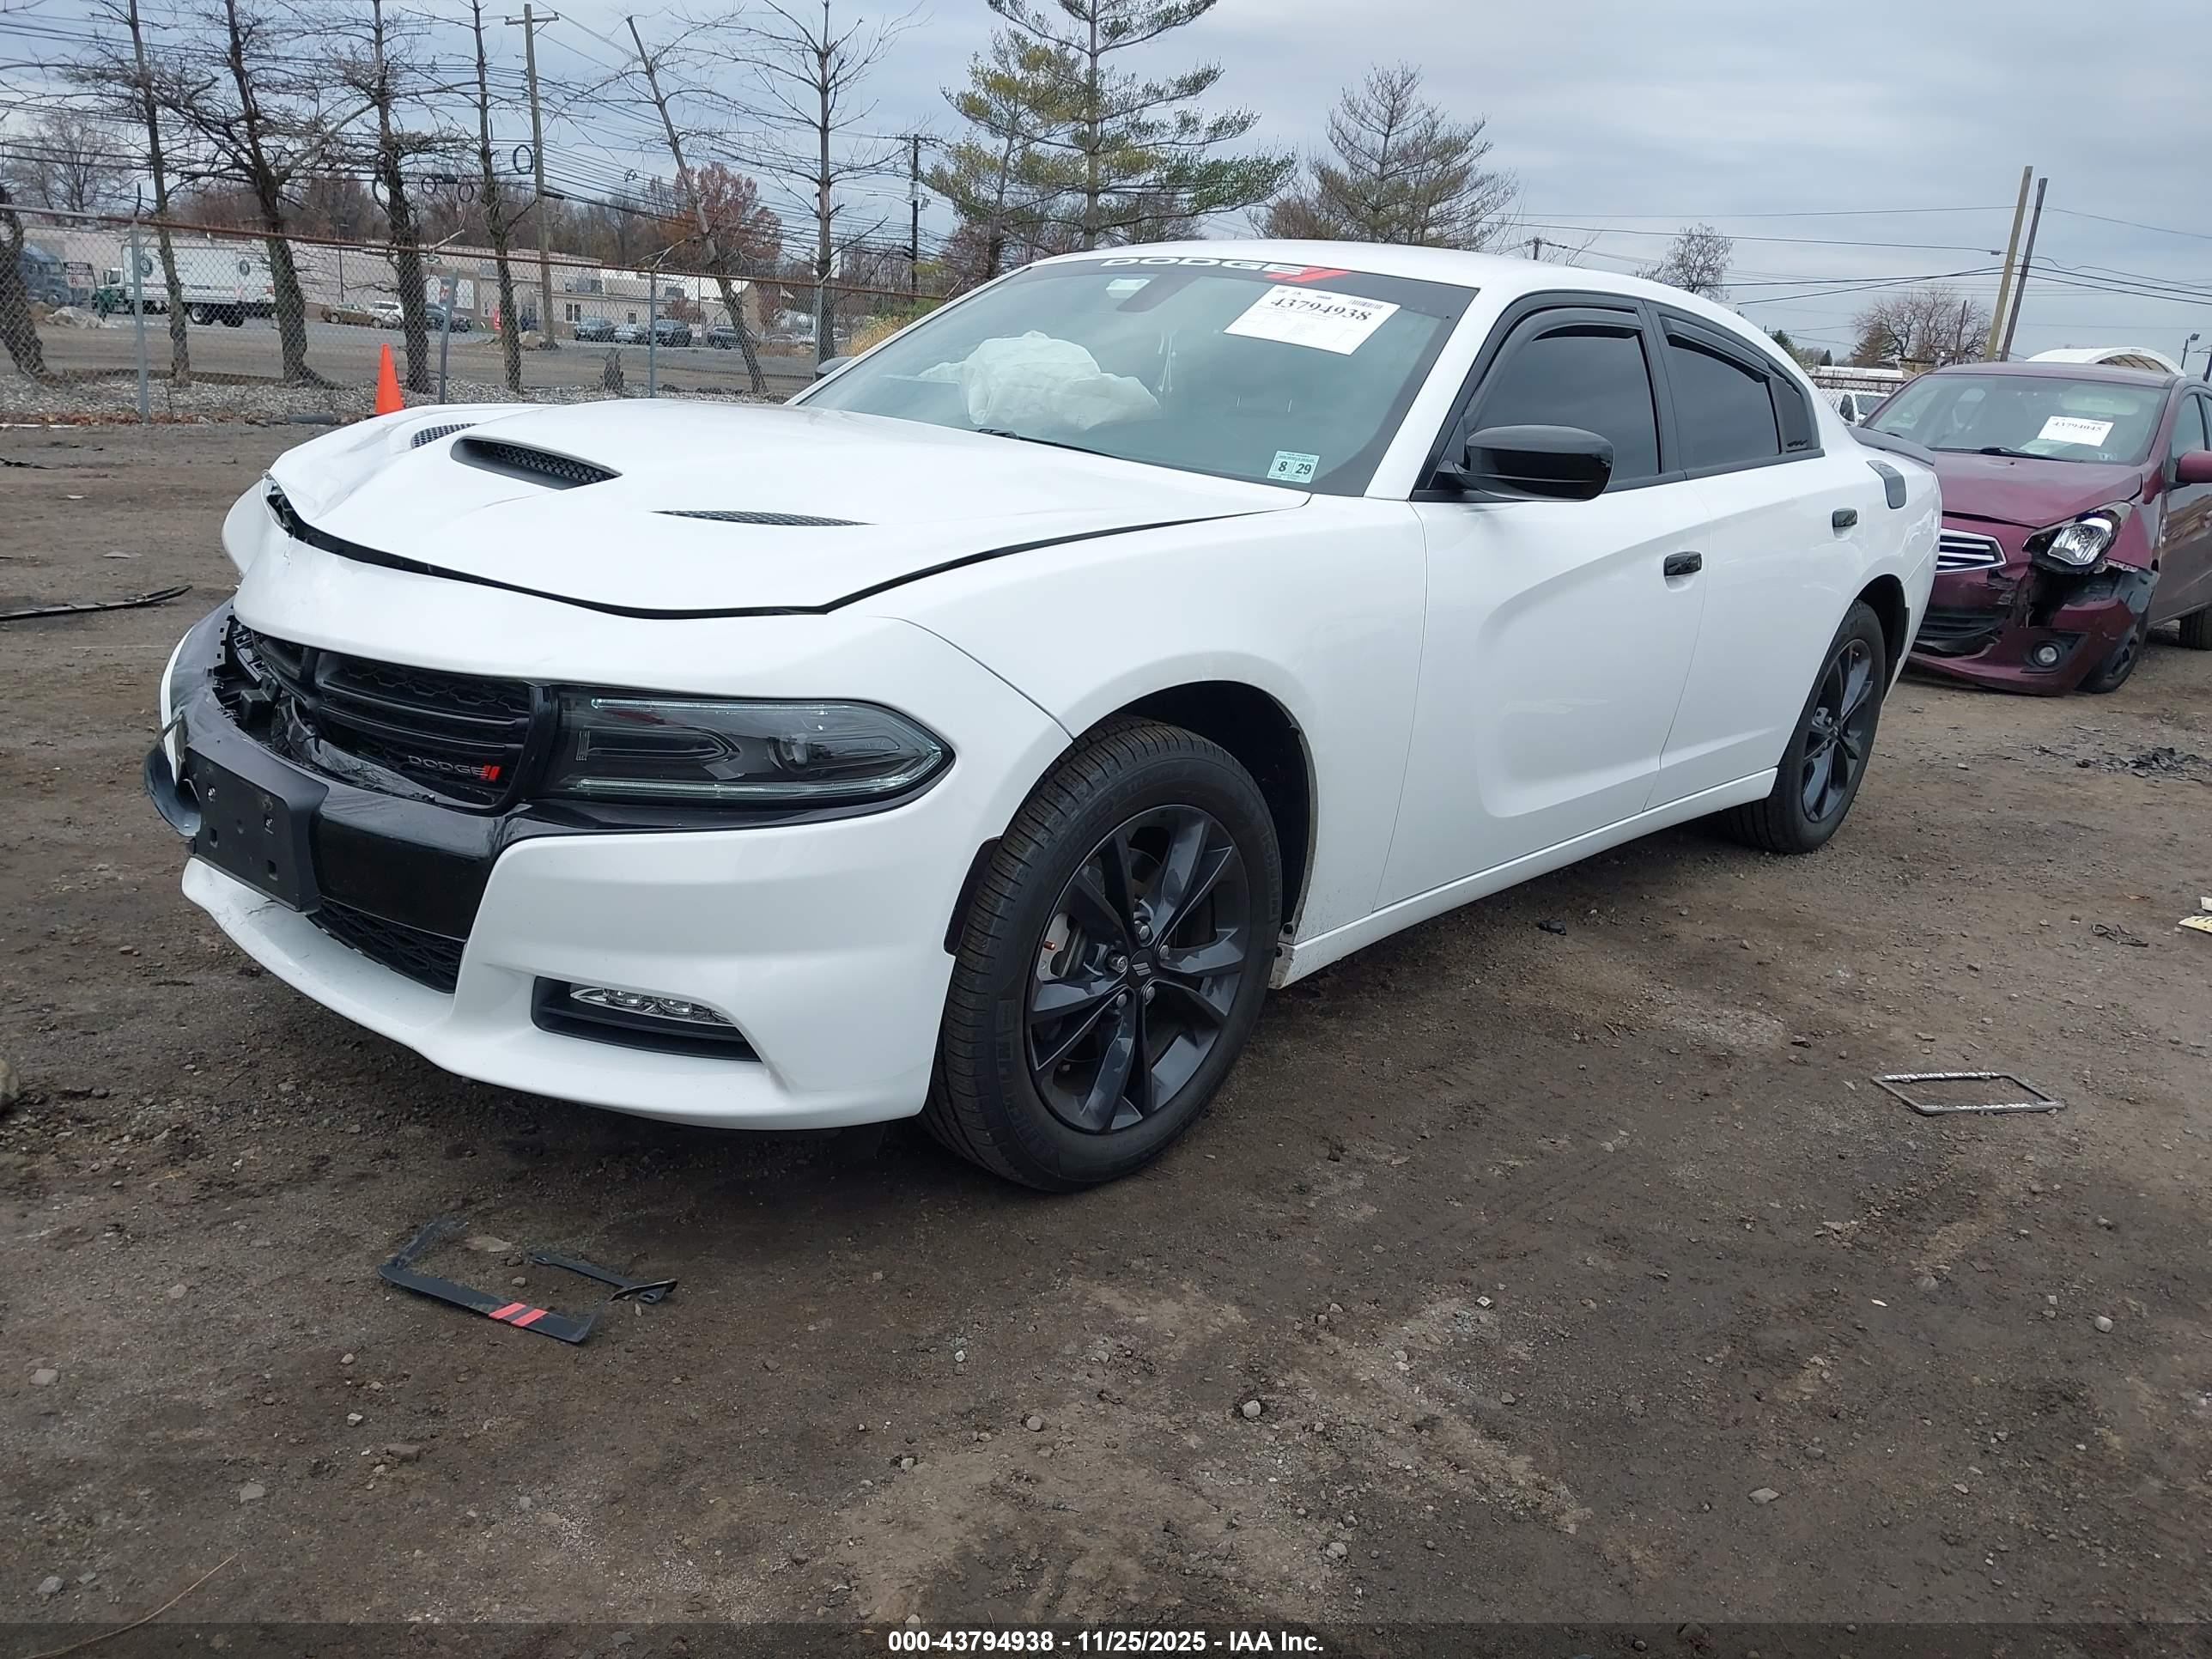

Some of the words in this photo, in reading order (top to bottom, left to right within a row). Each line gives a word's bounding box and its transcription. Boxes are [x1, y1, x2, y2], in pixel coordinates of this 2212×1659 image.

[1100, 258, 1303, 275] DODGE
[1271, 297, 1372, 321] 43794938
[1279, 461, 1288, 471] 8
[1295, 464, 1312, 474] 29
[407, 755, 489, 776] DODGE
